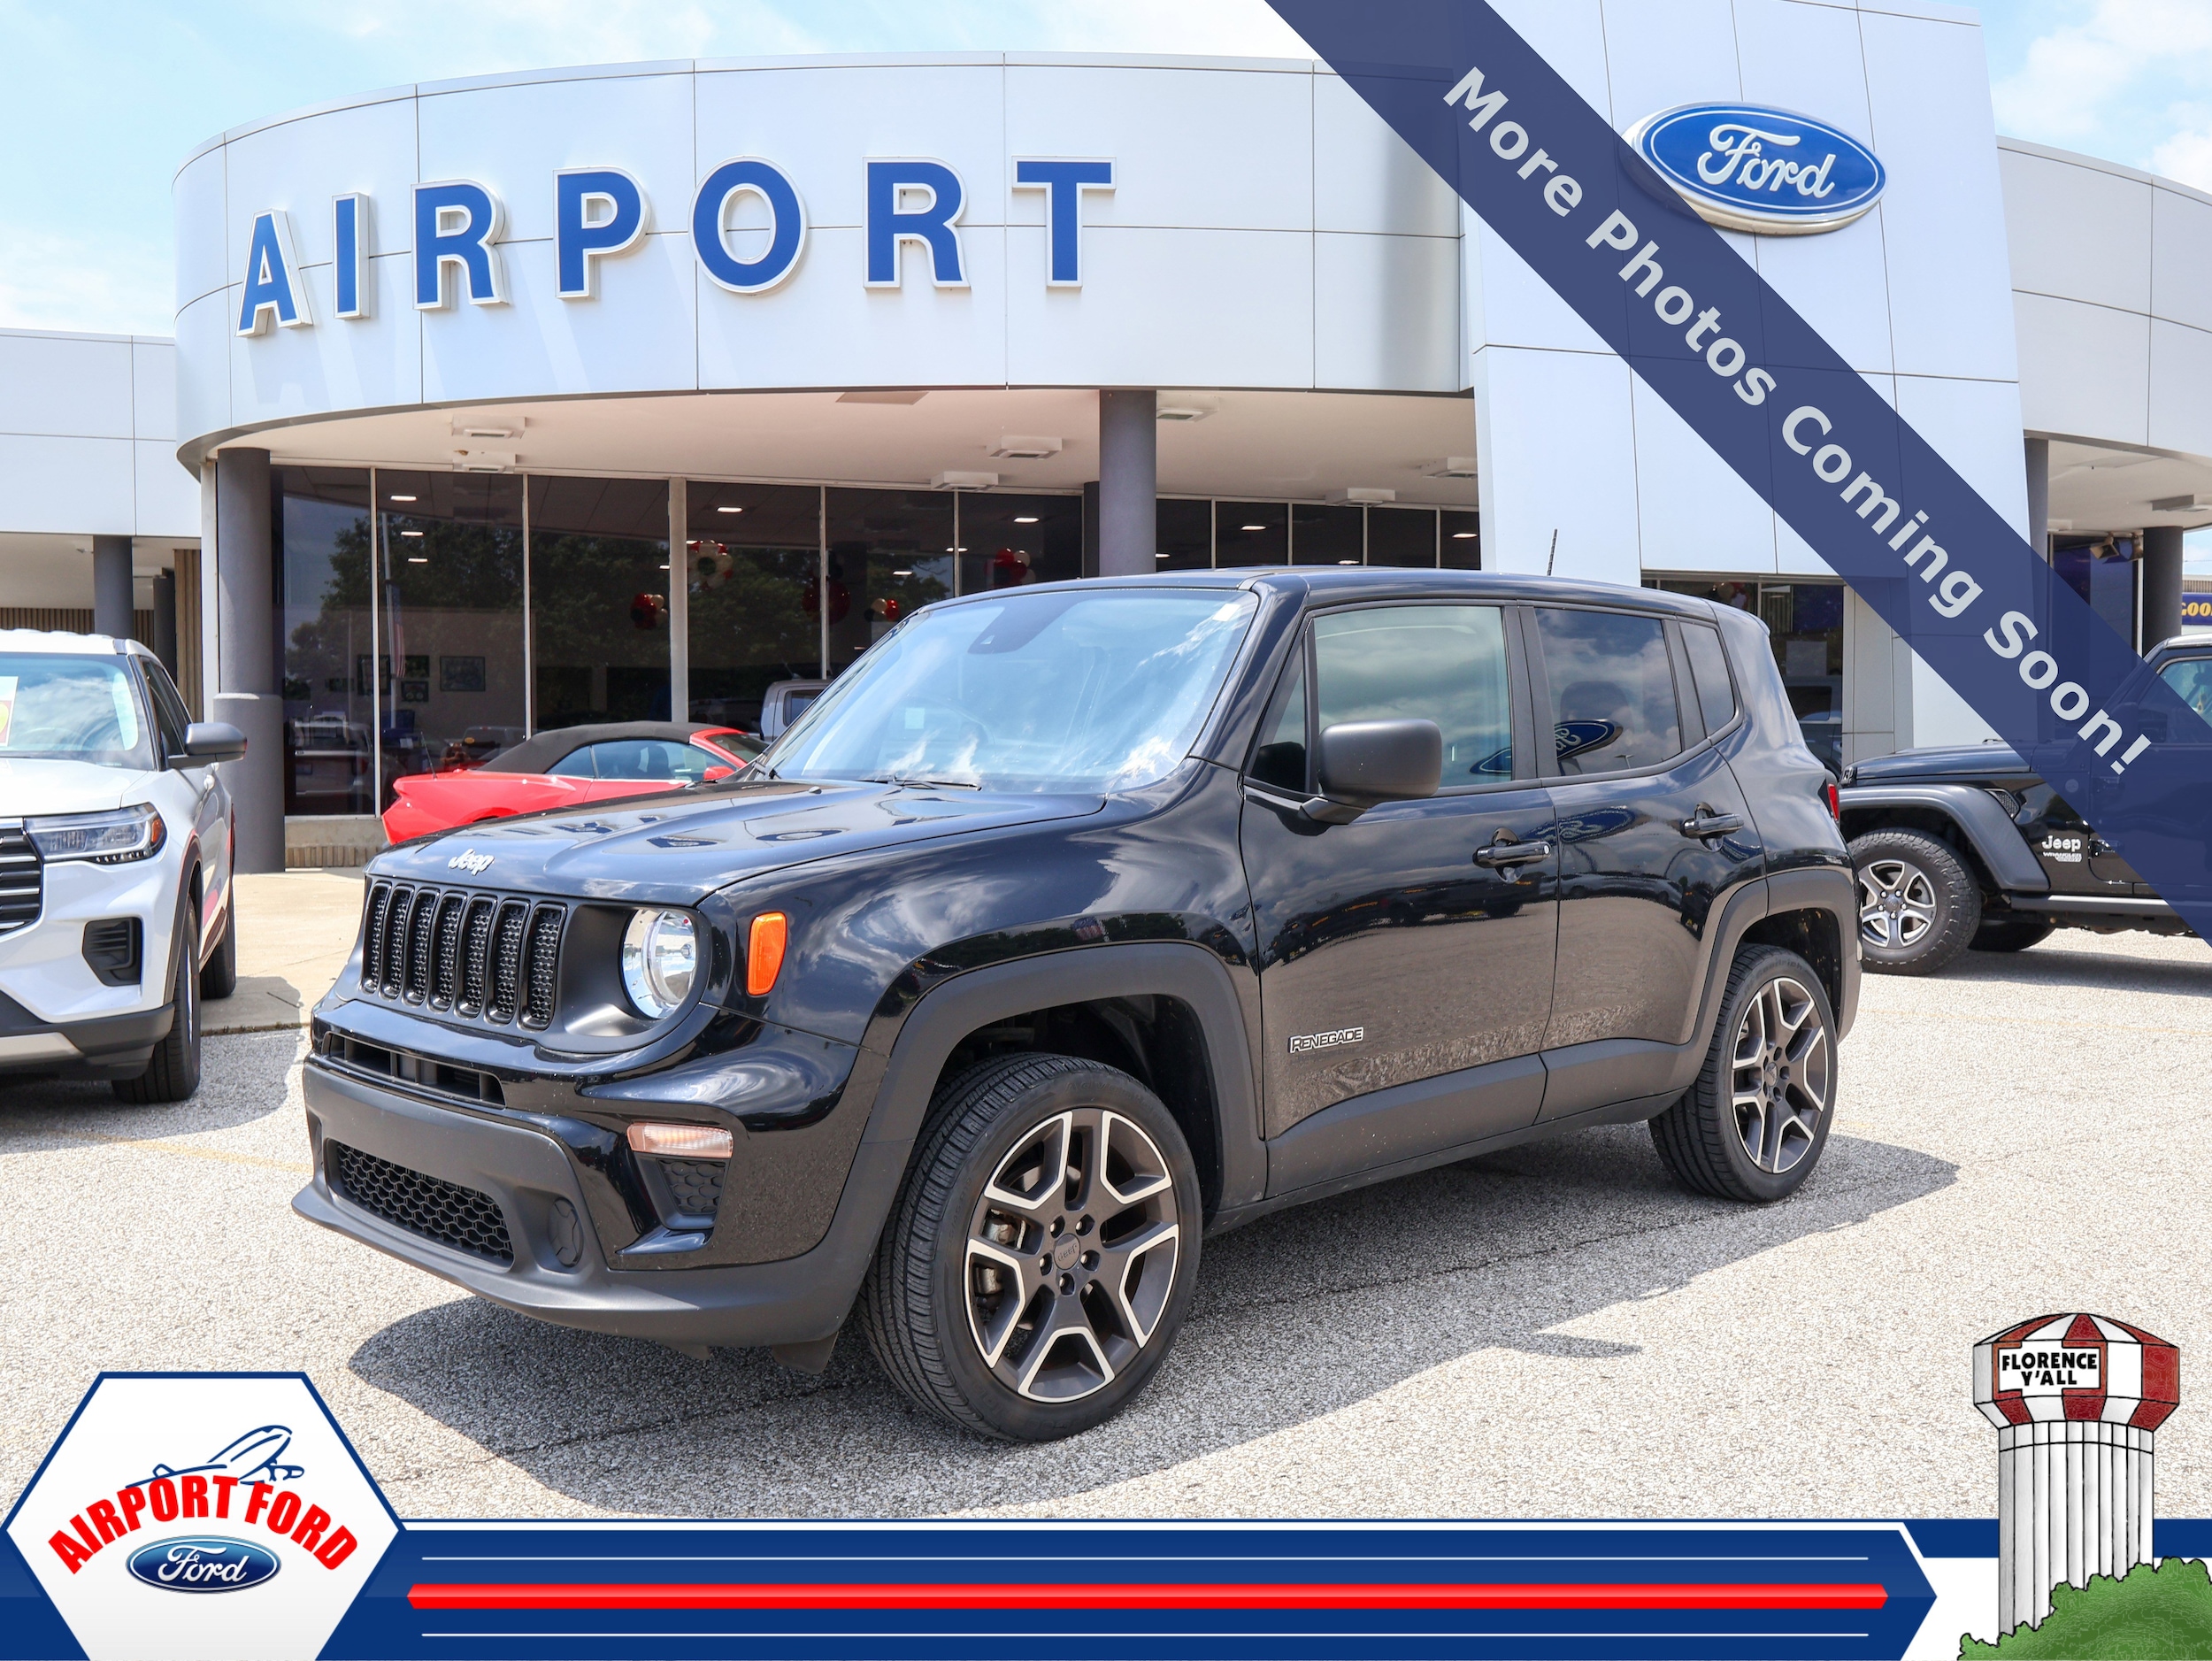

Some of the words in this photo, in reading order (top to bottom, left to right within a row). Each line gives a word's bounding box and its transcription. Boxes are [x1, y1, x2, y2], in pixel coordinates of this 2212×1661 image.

[1698, 123, 1837, 199] Ford
[235, 155, 1117, 336] AIRPORT
[2041, 834, 2081, 852] Jeep
[448, 848, 495, 876] Jeep
[1288, 1027, 1364, 1054] RENEGADE
